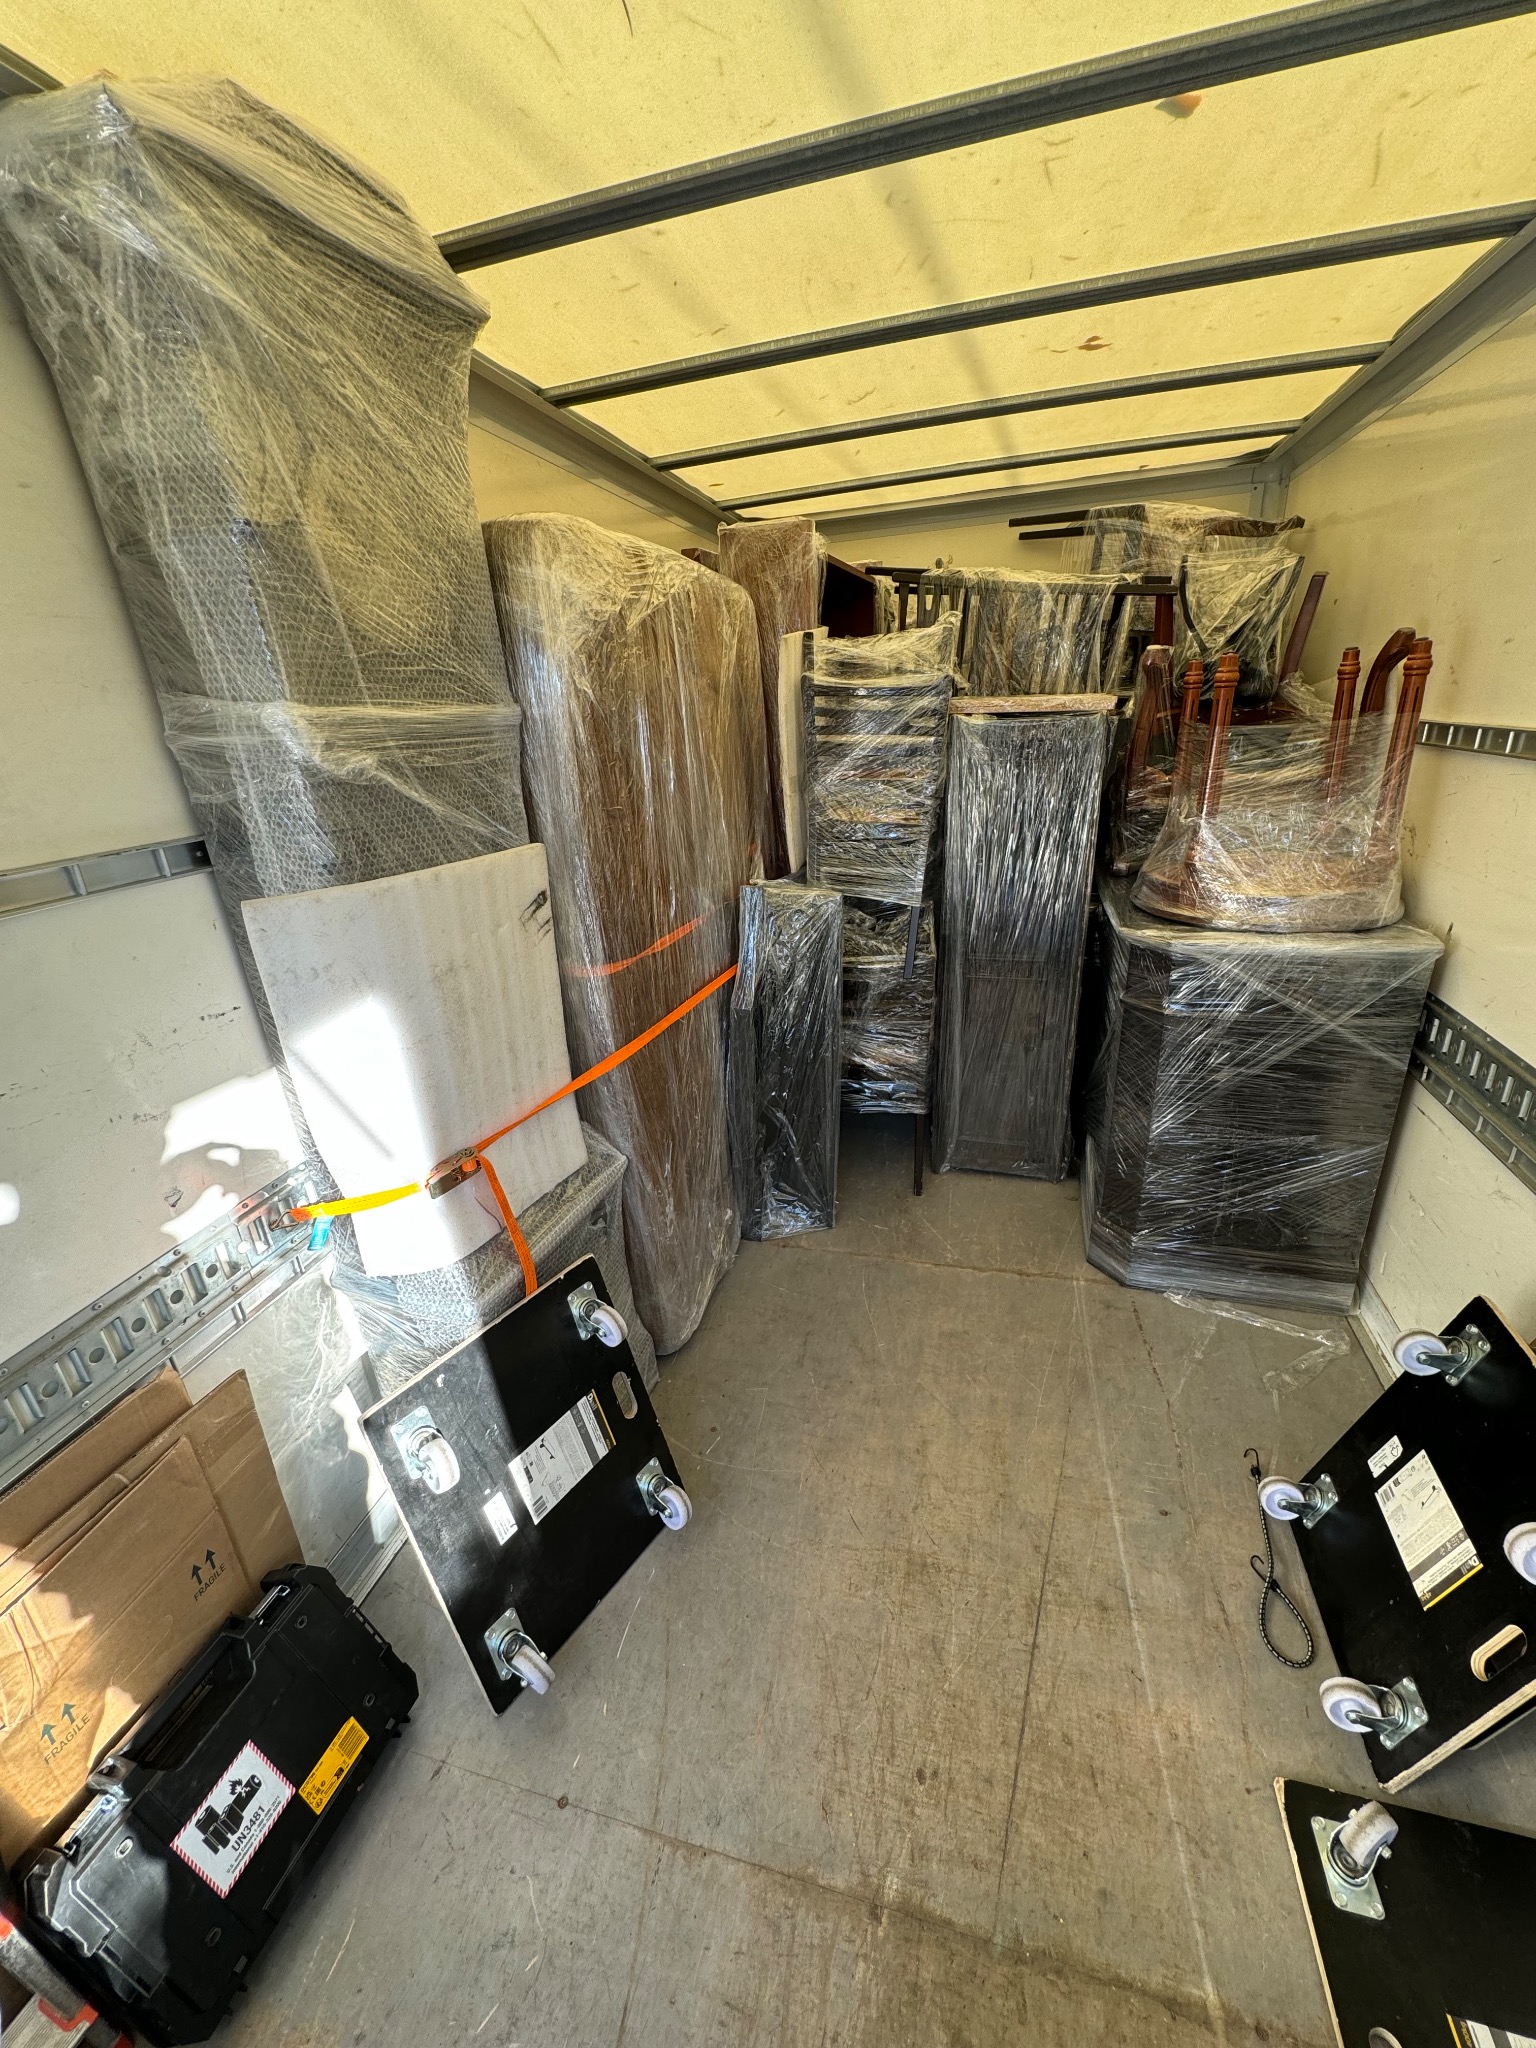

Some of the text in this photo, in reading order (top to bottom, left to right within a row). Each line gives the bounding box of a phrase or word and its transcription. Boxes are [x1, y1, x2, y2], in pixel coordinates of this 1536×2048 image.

[193, 1562, 226, 1601] FRAGILE
[44, 1713, 90, 1764] FRAGILE
[231, 1805, 265, 1852] UN3481
[231, 1841, 254, 1874] International
